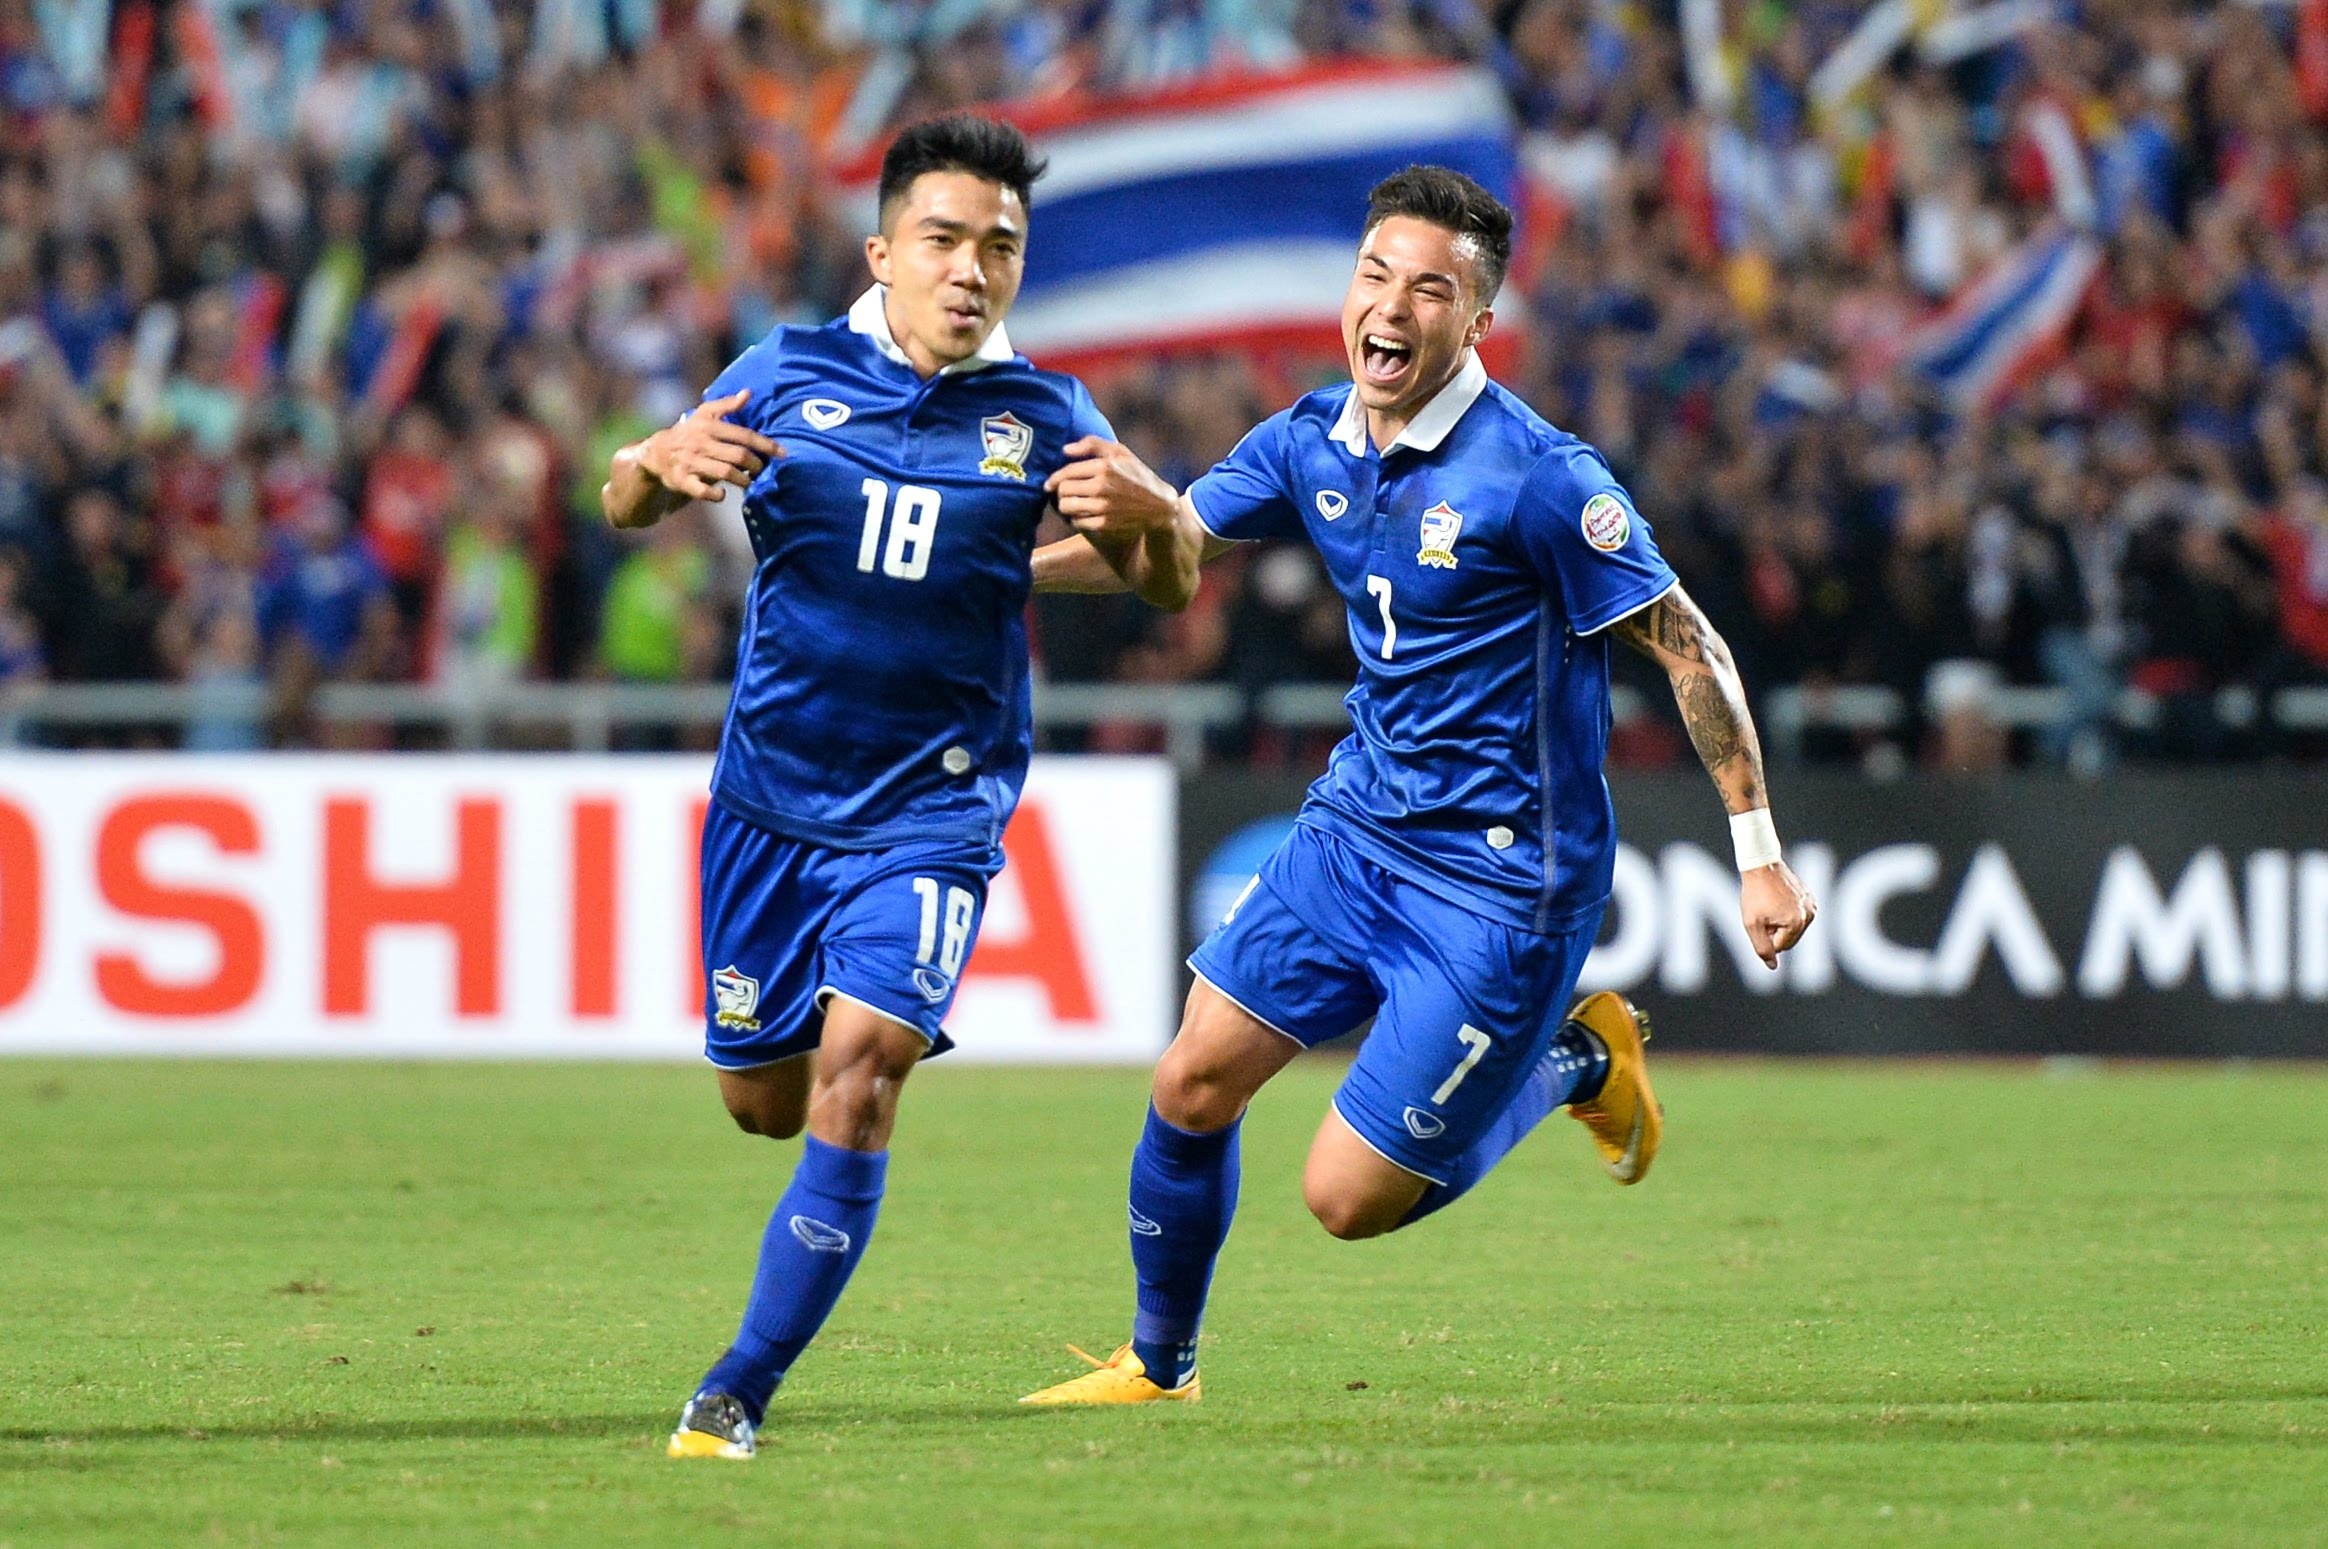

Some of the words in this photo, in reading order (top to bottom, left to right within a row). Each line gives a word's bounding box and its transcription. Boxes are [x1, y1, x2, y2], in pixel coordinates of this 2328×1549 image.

[857, 478, 942, 581] 18
[1366, 574, 1396, 660] 7
[0, 794, 1100, 1020] SHIA
[912, 876, 975, 980] 18
[2077, 845, 2328, 999] MI
[1431, 1023, 1491, 1105] 7
